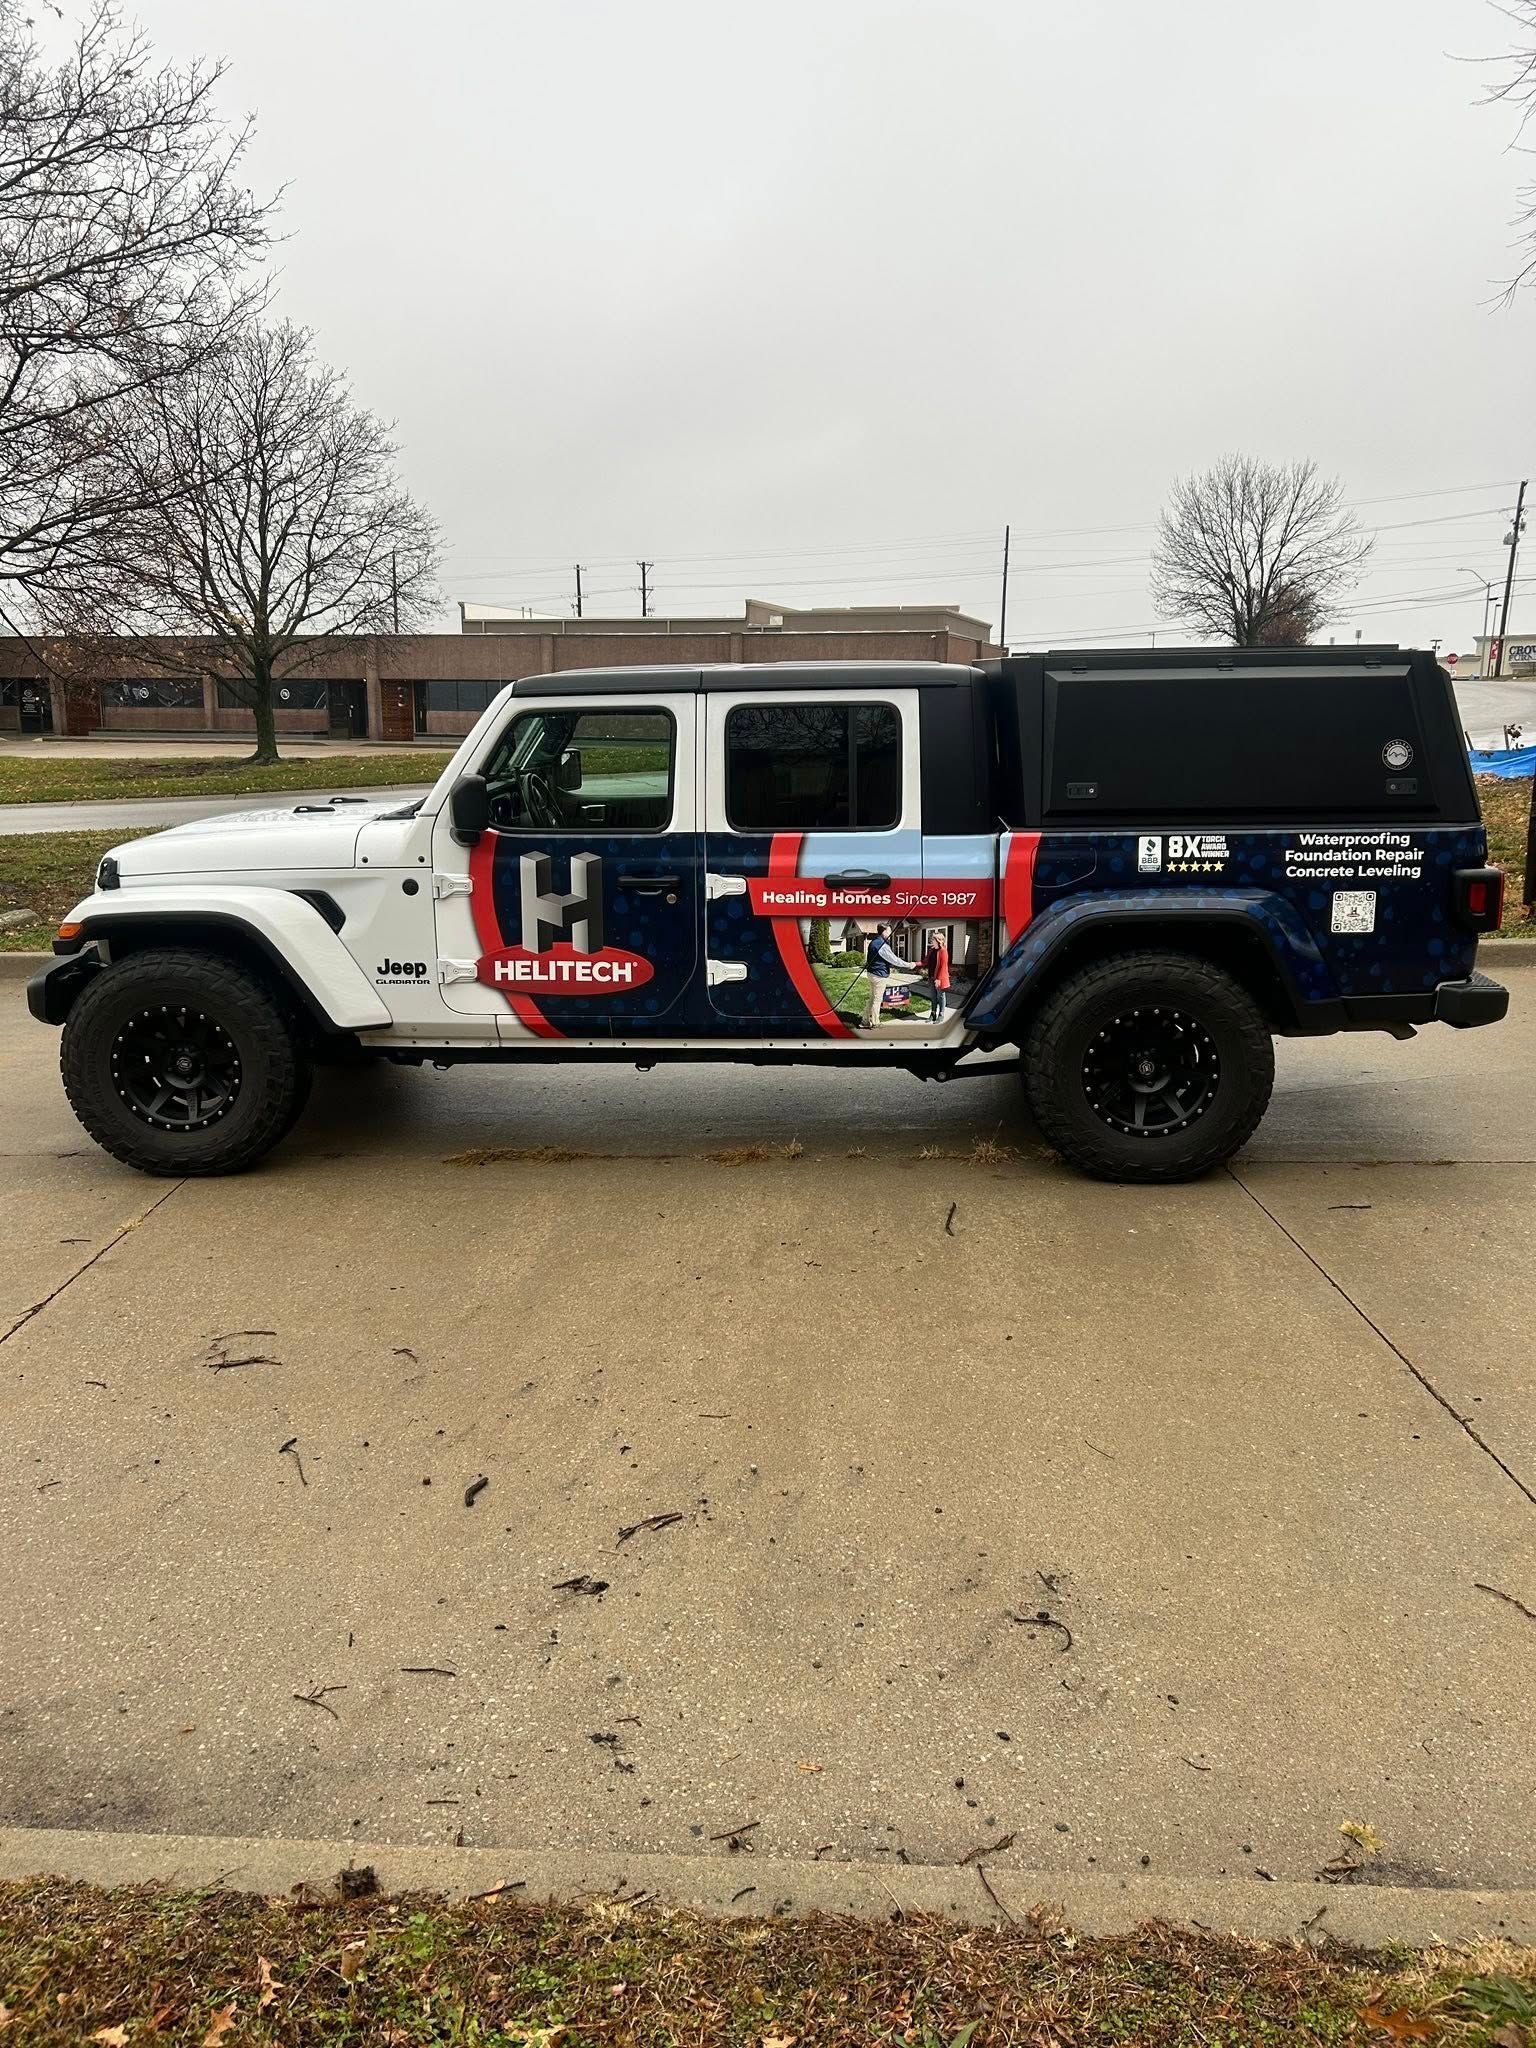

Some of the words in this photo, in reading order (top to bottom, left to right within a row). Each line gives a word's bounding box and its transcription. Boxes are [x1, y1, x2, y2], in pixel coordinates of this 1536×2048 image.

[1201, 835, 1226, 843] TORCH
[1299, 832, 1410, 847] Waterproofing
[1168, 835, 1201, 858] 8X
[1201, 850, 1230, 858] WINNER
[1285, 849, 1371, 861] Foundation
[1375, 848, 1424, 862] Repair
[1286, 866, 1354, 877] Concrete
[1358, 864, 1421, 878] Leveling
[762, 891, 827, 906] Healing
[832, 891, 891, 905] Homes
[895, 892, 938, 905] Since
[941, 892, 976, 905] 1987
[376, 958, 428, 978] Jeep
